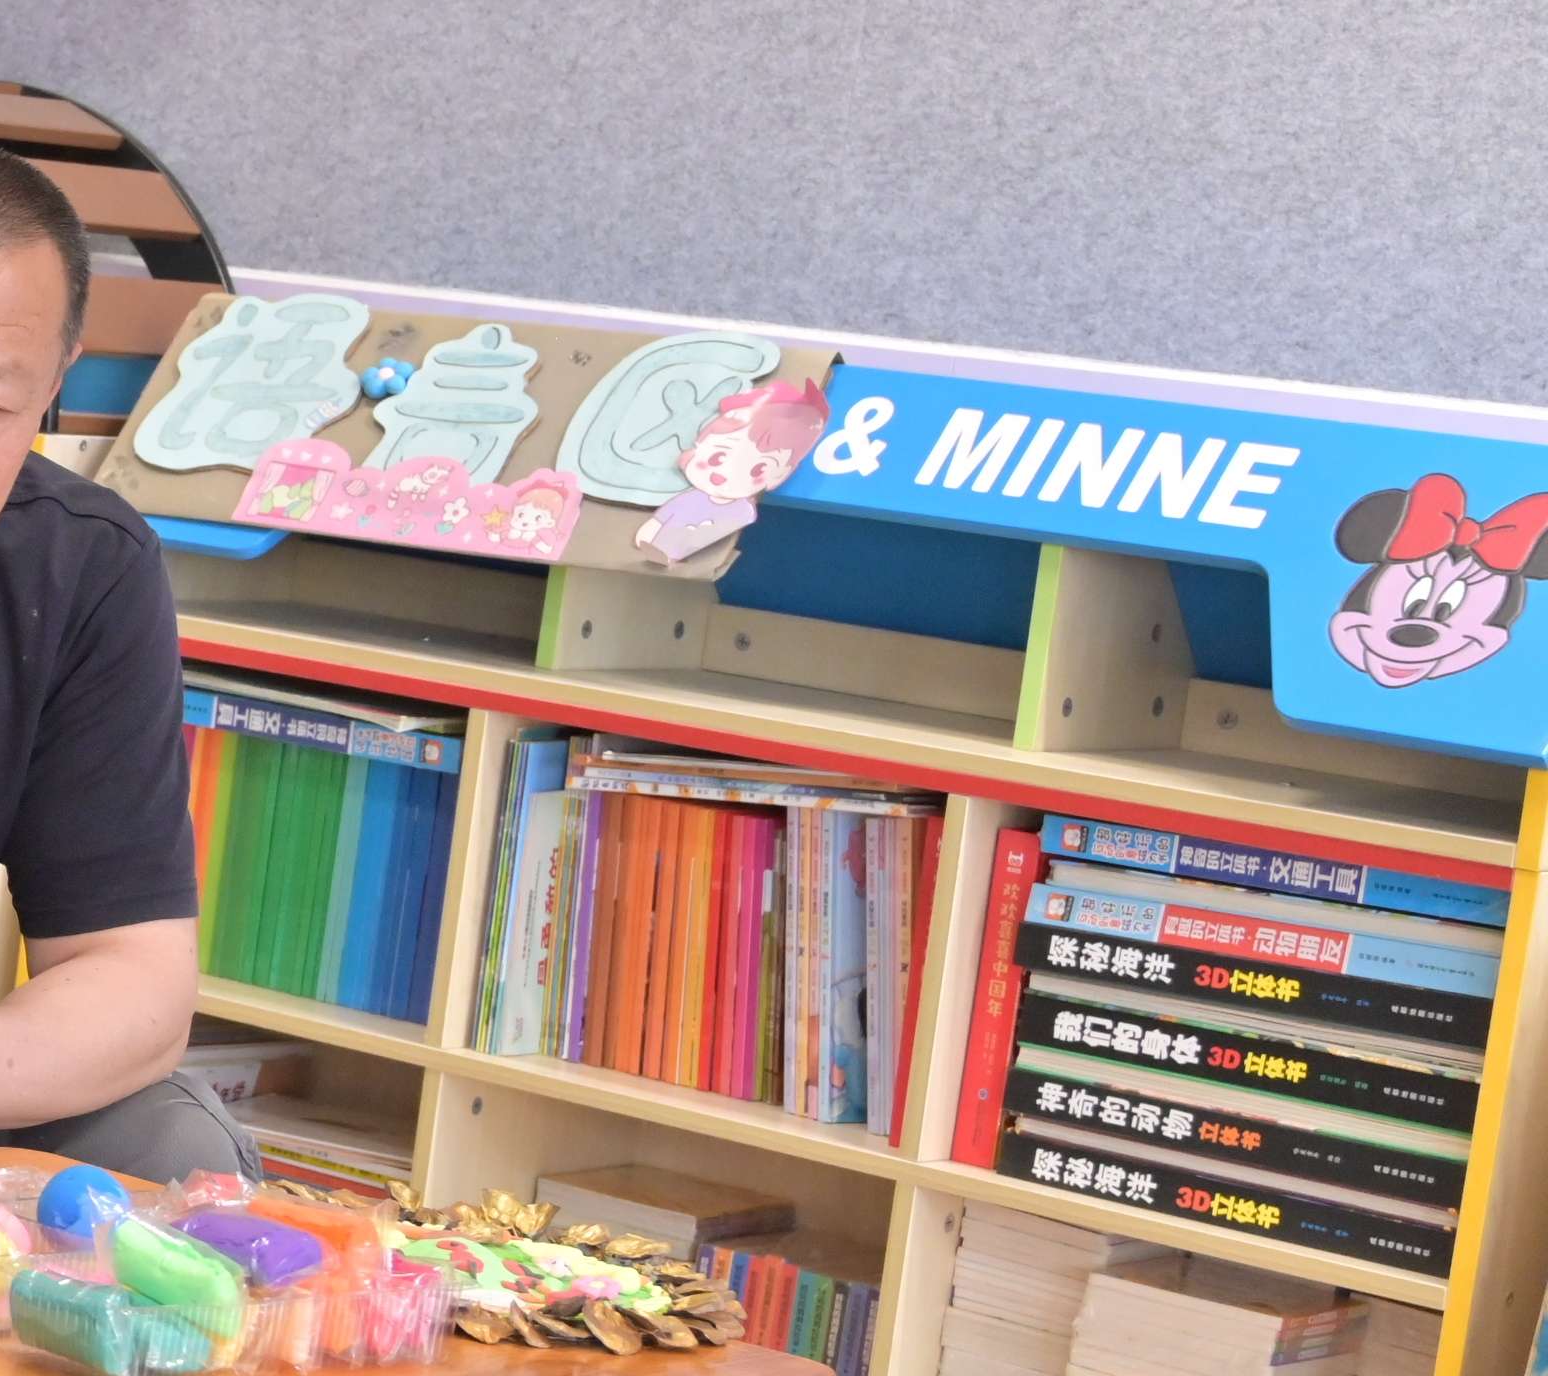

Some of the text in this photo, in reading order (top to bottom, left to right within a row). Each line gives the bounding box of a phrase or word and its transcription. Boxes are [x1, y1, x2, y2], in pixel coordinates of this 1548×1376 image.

[813, 396, 1302, 530] & MINNE
[1047, 934, 1176, 984] 探秘海洋
[1053, 1010, 1203, 1066] 我们的身体
[1036, 1081, 1195, 1141] 神奇的动物
[1198, 1120, 1263, 1152] 立体书
[1030, 1147, 1159, 1205] 探秘海洋
